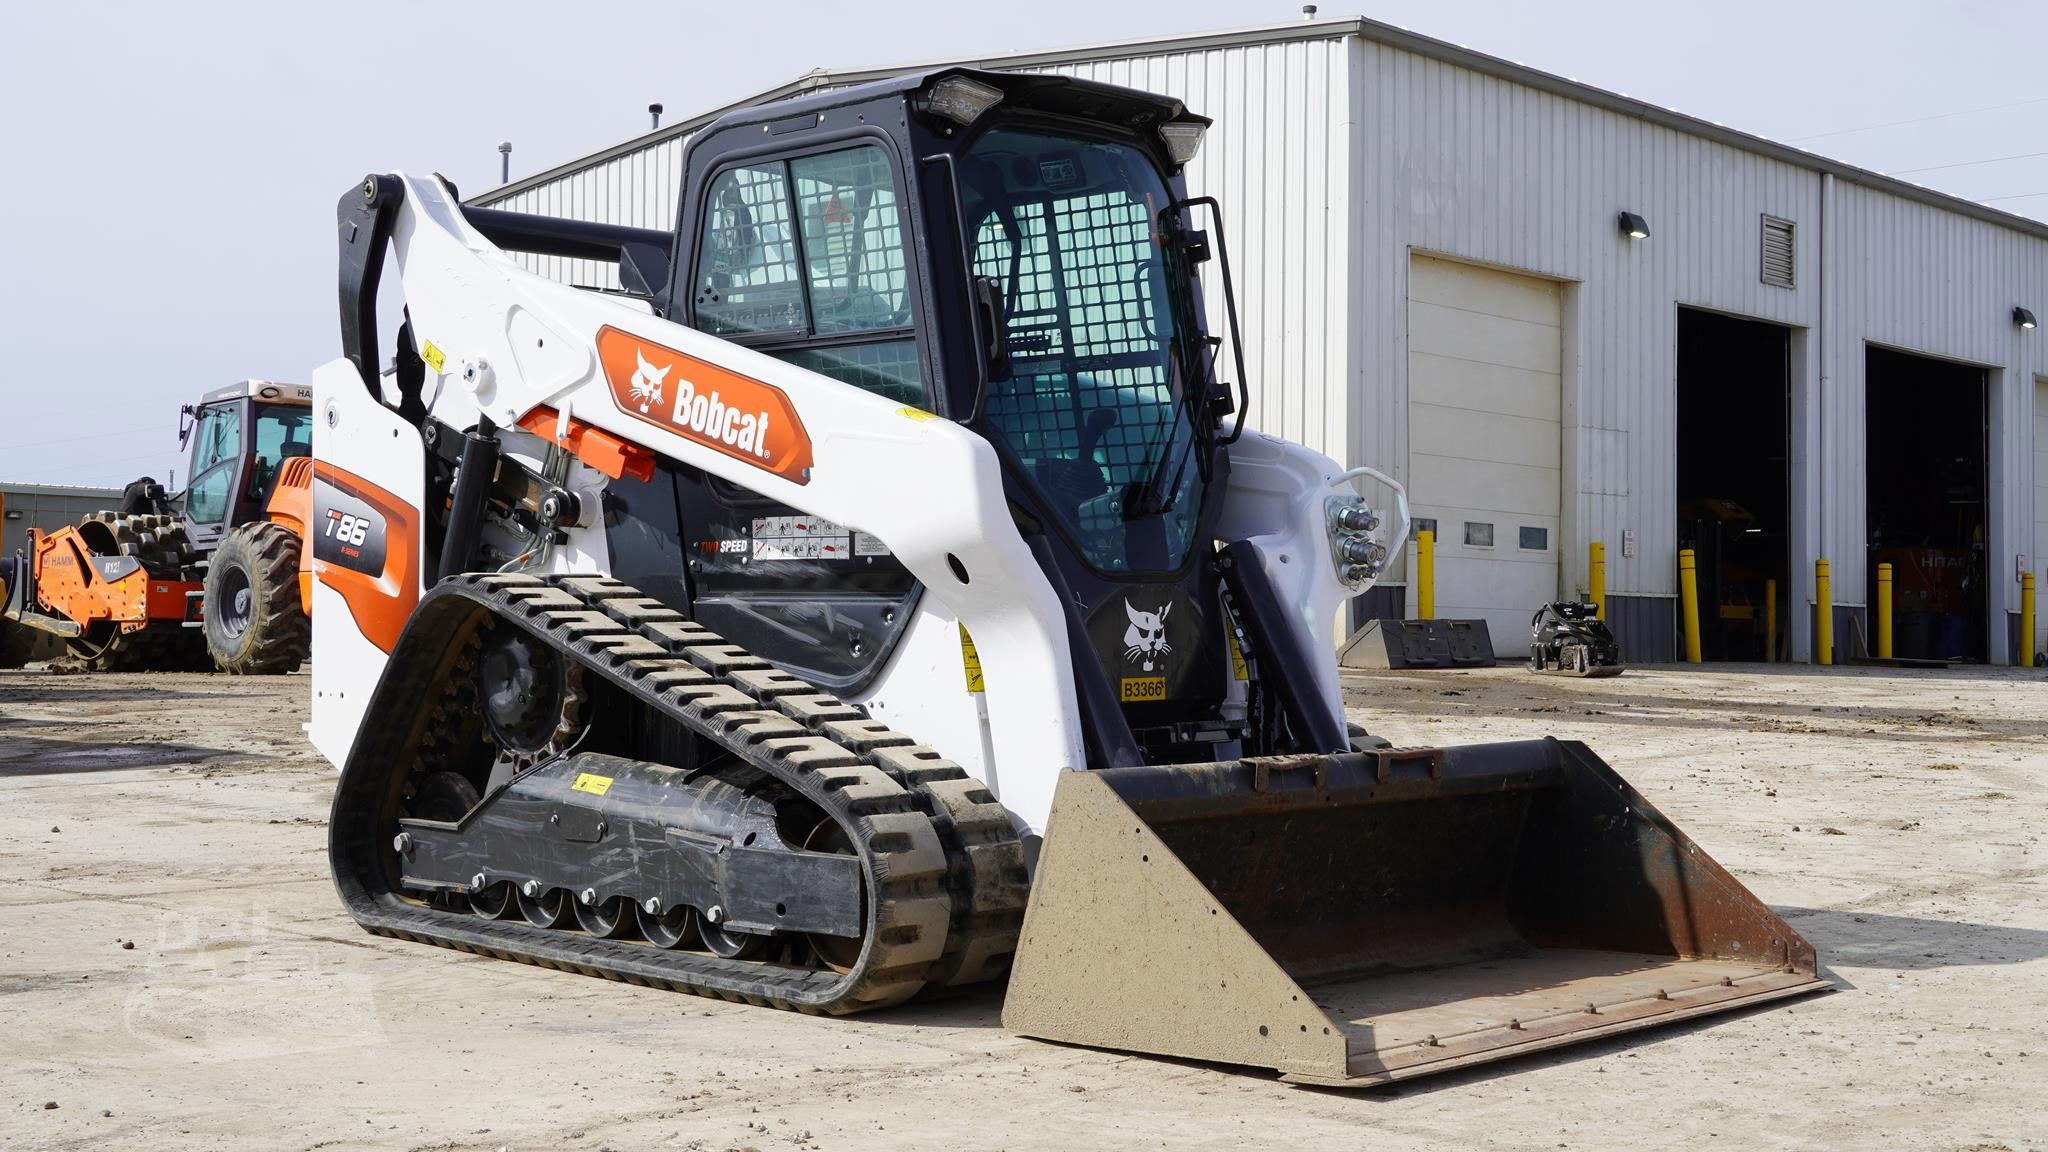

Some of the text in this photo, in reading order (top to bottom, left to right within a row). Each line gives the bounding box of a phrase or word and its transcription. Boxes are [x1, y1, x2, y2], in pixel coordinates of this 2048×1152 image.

[297, 388, 312, 398] HA
[672, 378, 769, 457] Bobcat
[325, 508, 370, 546] T86
[700, 539, 748, 553] TWO SPEED
[51, 555, 73, 566] HAMM
[1124, 681, 1162, 697] B3366
